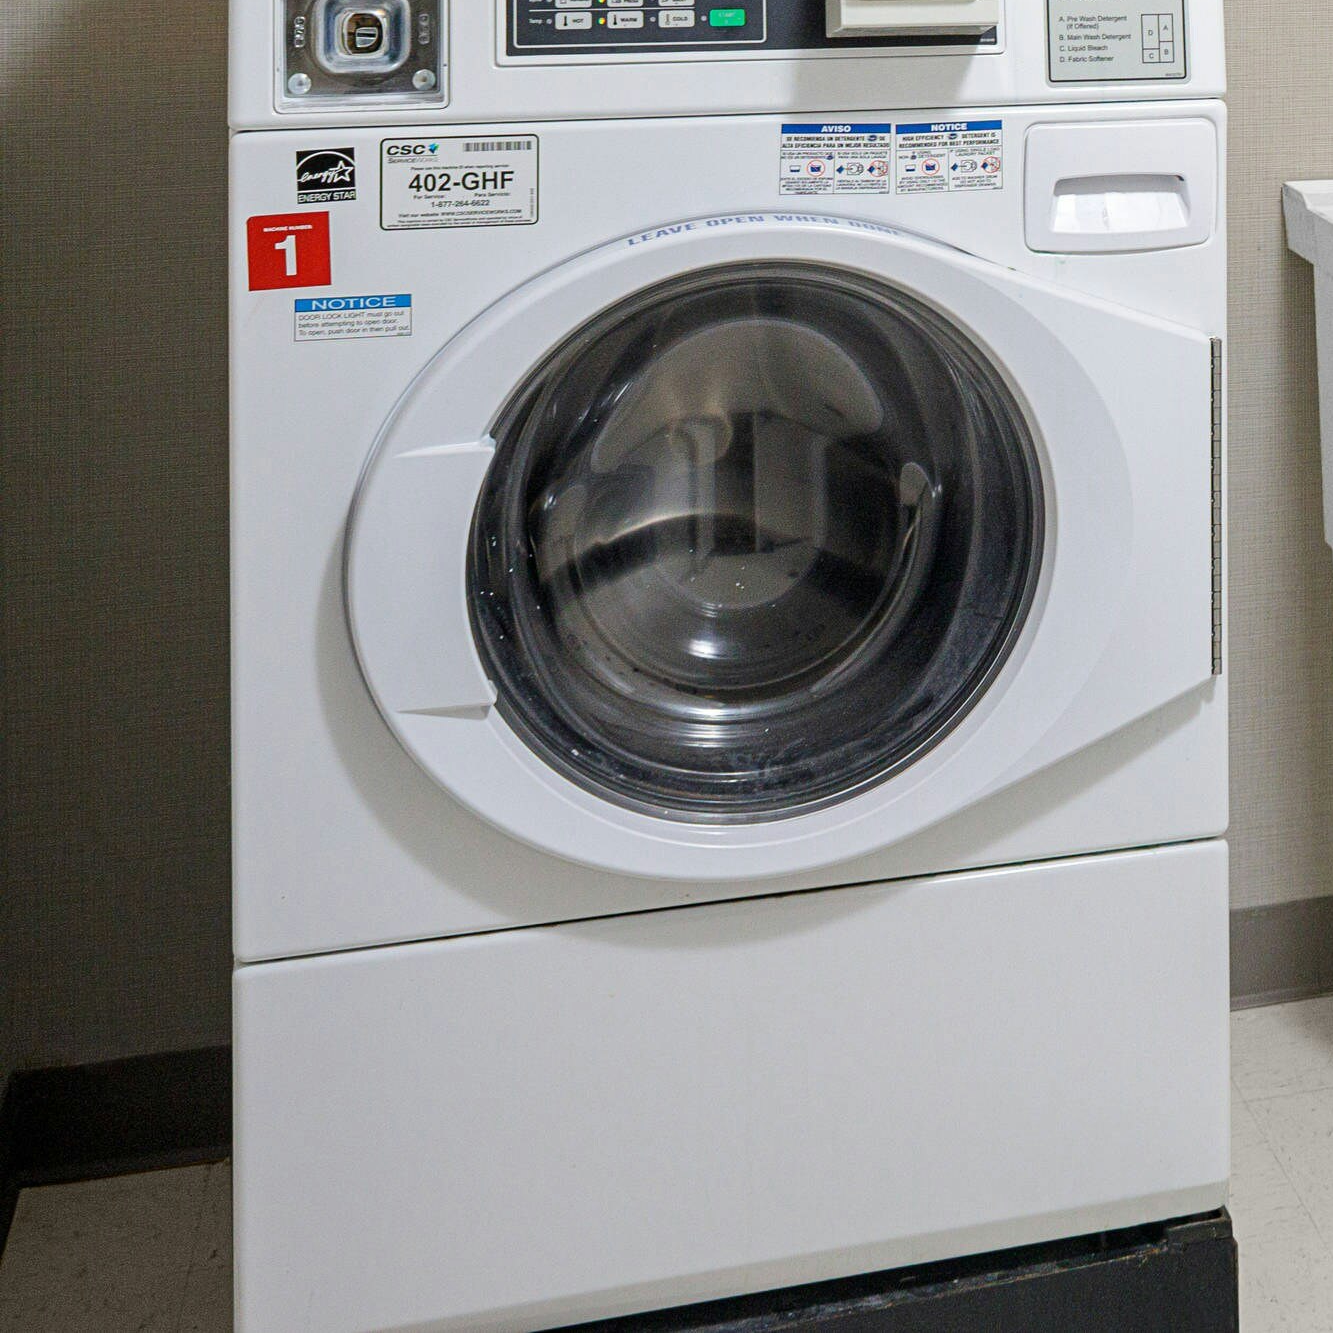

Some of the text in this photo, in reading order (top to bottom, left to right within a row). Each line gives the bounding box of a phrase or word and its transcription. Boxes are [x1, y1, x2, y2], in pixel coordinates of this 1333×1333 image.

[931, 123, 967, 131] NOTICE
[387, 145, 425, 156] CSC
[408, 171, 514, 192] 402-GHF
[298, 191, 355, 202] ENERGY STAR
[628, 223, 697, 246] LEAVE
[706, 215, 765, 227] OPEN
[774, 215, 839, 225] WHEN
[275, 235, 297, 276] 1
[311, 297, 397, 310] NOTICE
